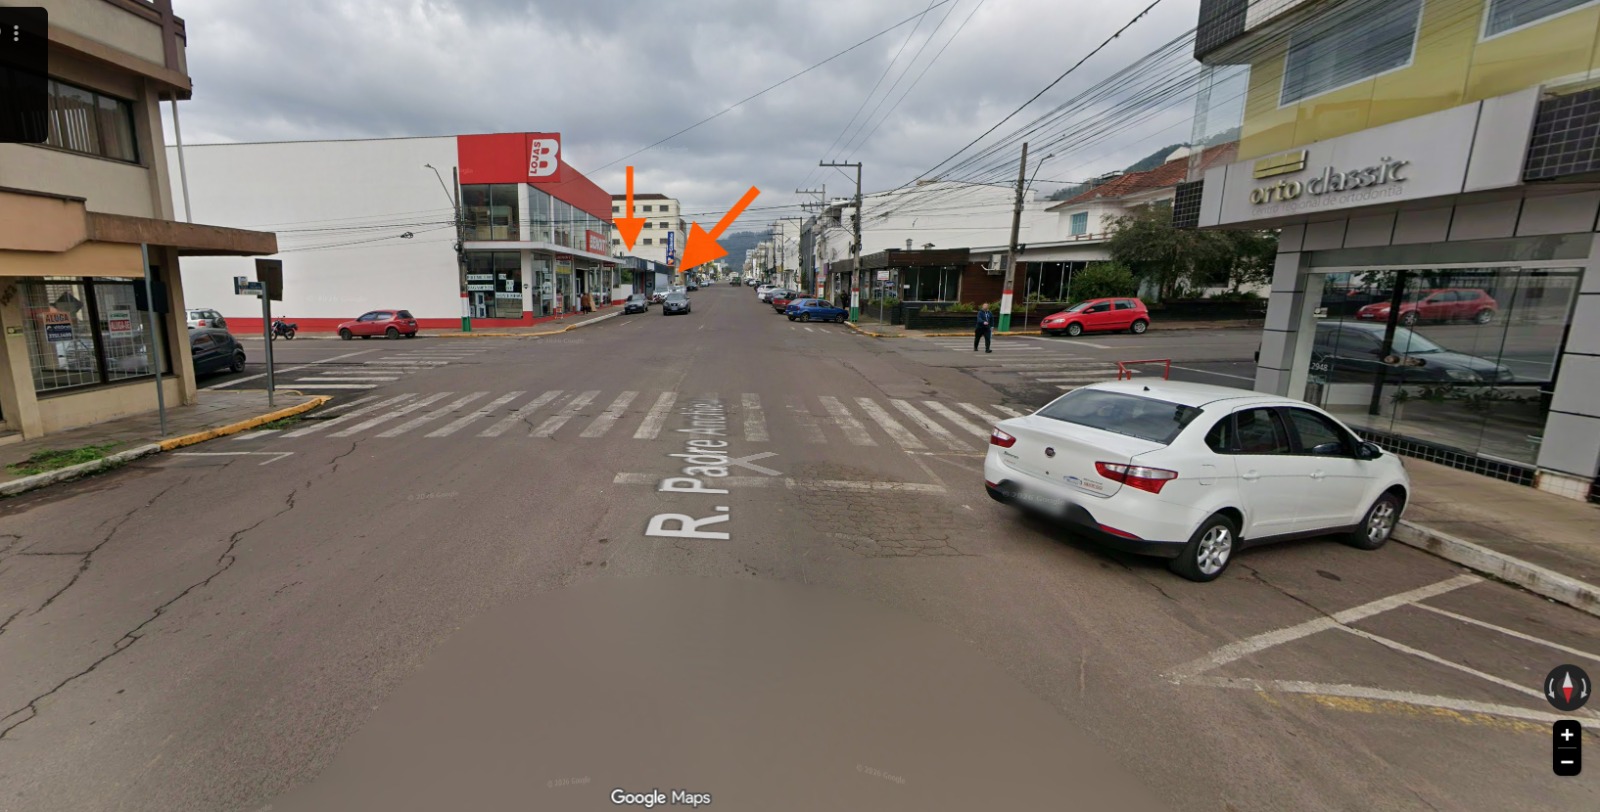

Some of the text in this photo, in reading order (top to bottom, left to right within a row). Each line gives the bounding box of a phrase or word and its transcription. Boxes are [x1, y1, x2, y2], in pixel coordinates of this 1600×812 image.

[528, 138, 559, 177] B
[529, 141, 541, 174] LOJAS
[1250, 180, 1303, 205] orto
[1251, 185, 1404, 216] centro regional de ortodontia
[45, 313, 69, 323] ALUGA
[1311, 362, 1328, 372] 2948
